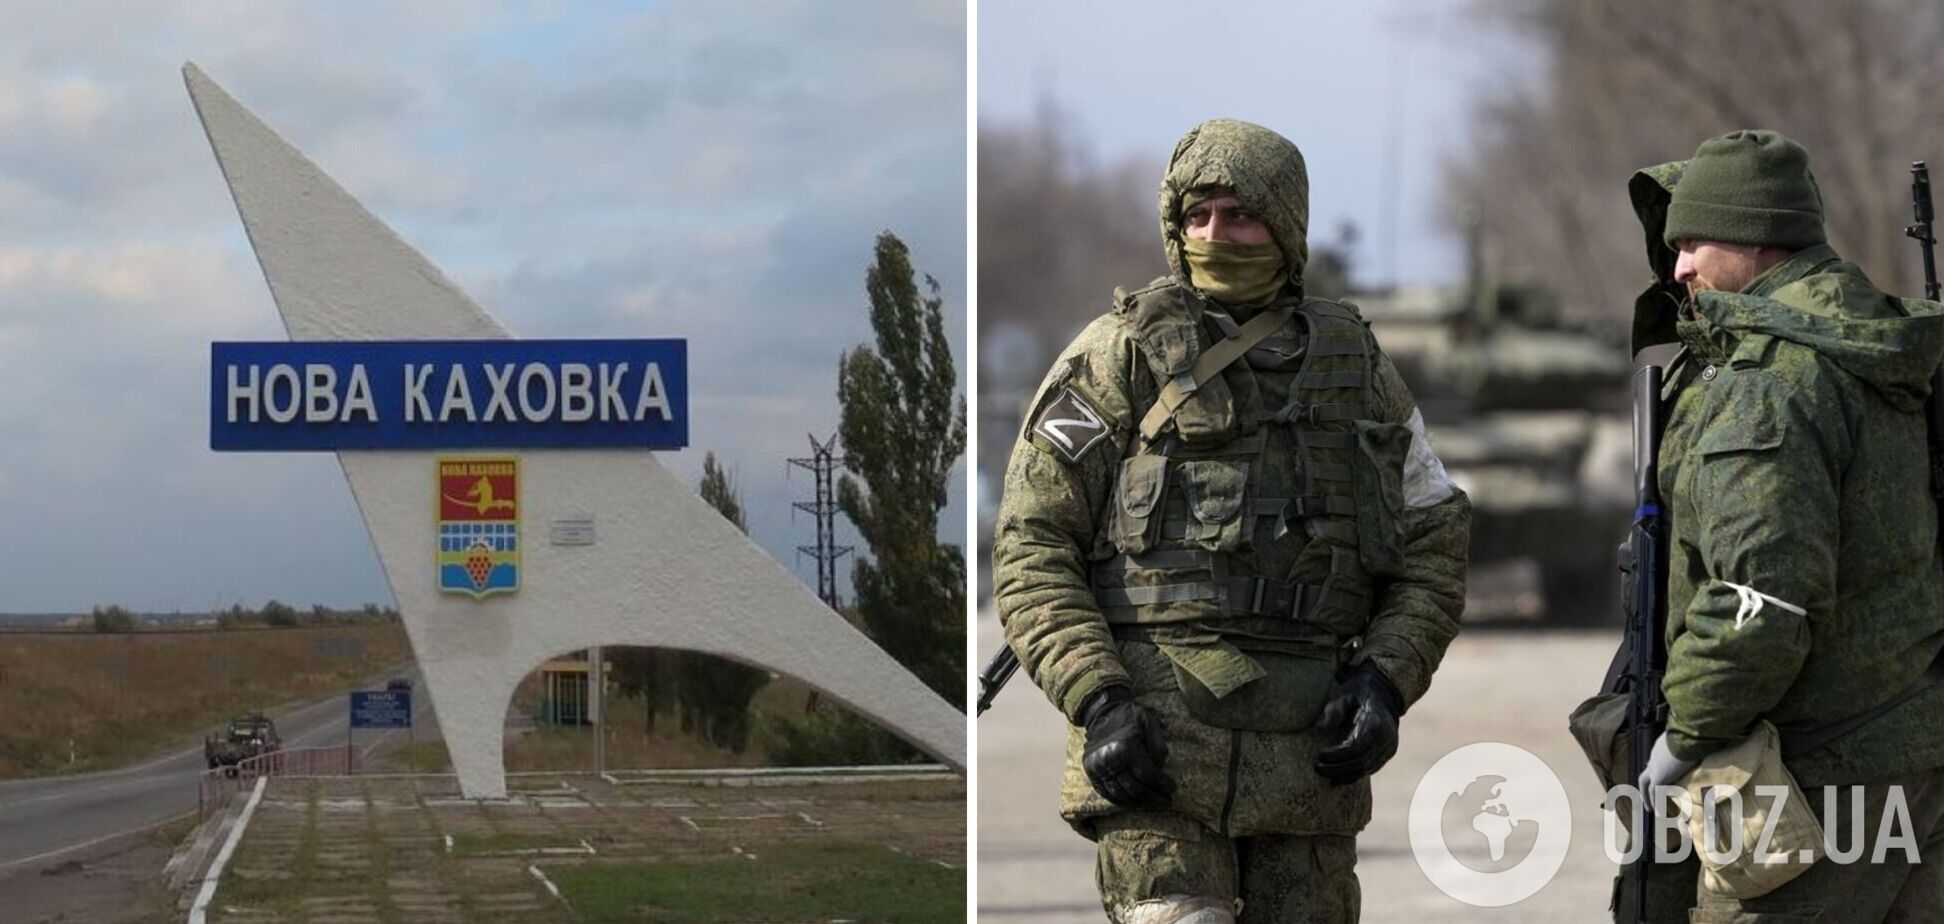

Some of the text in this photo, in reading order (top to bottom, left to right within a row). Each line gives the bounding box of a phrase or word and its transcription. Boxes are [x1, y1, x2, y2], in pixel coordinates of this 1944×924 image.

[227, 362, 673, 423] НОВА КАХОВКА
[1044, 397, 1101, 449] Z
